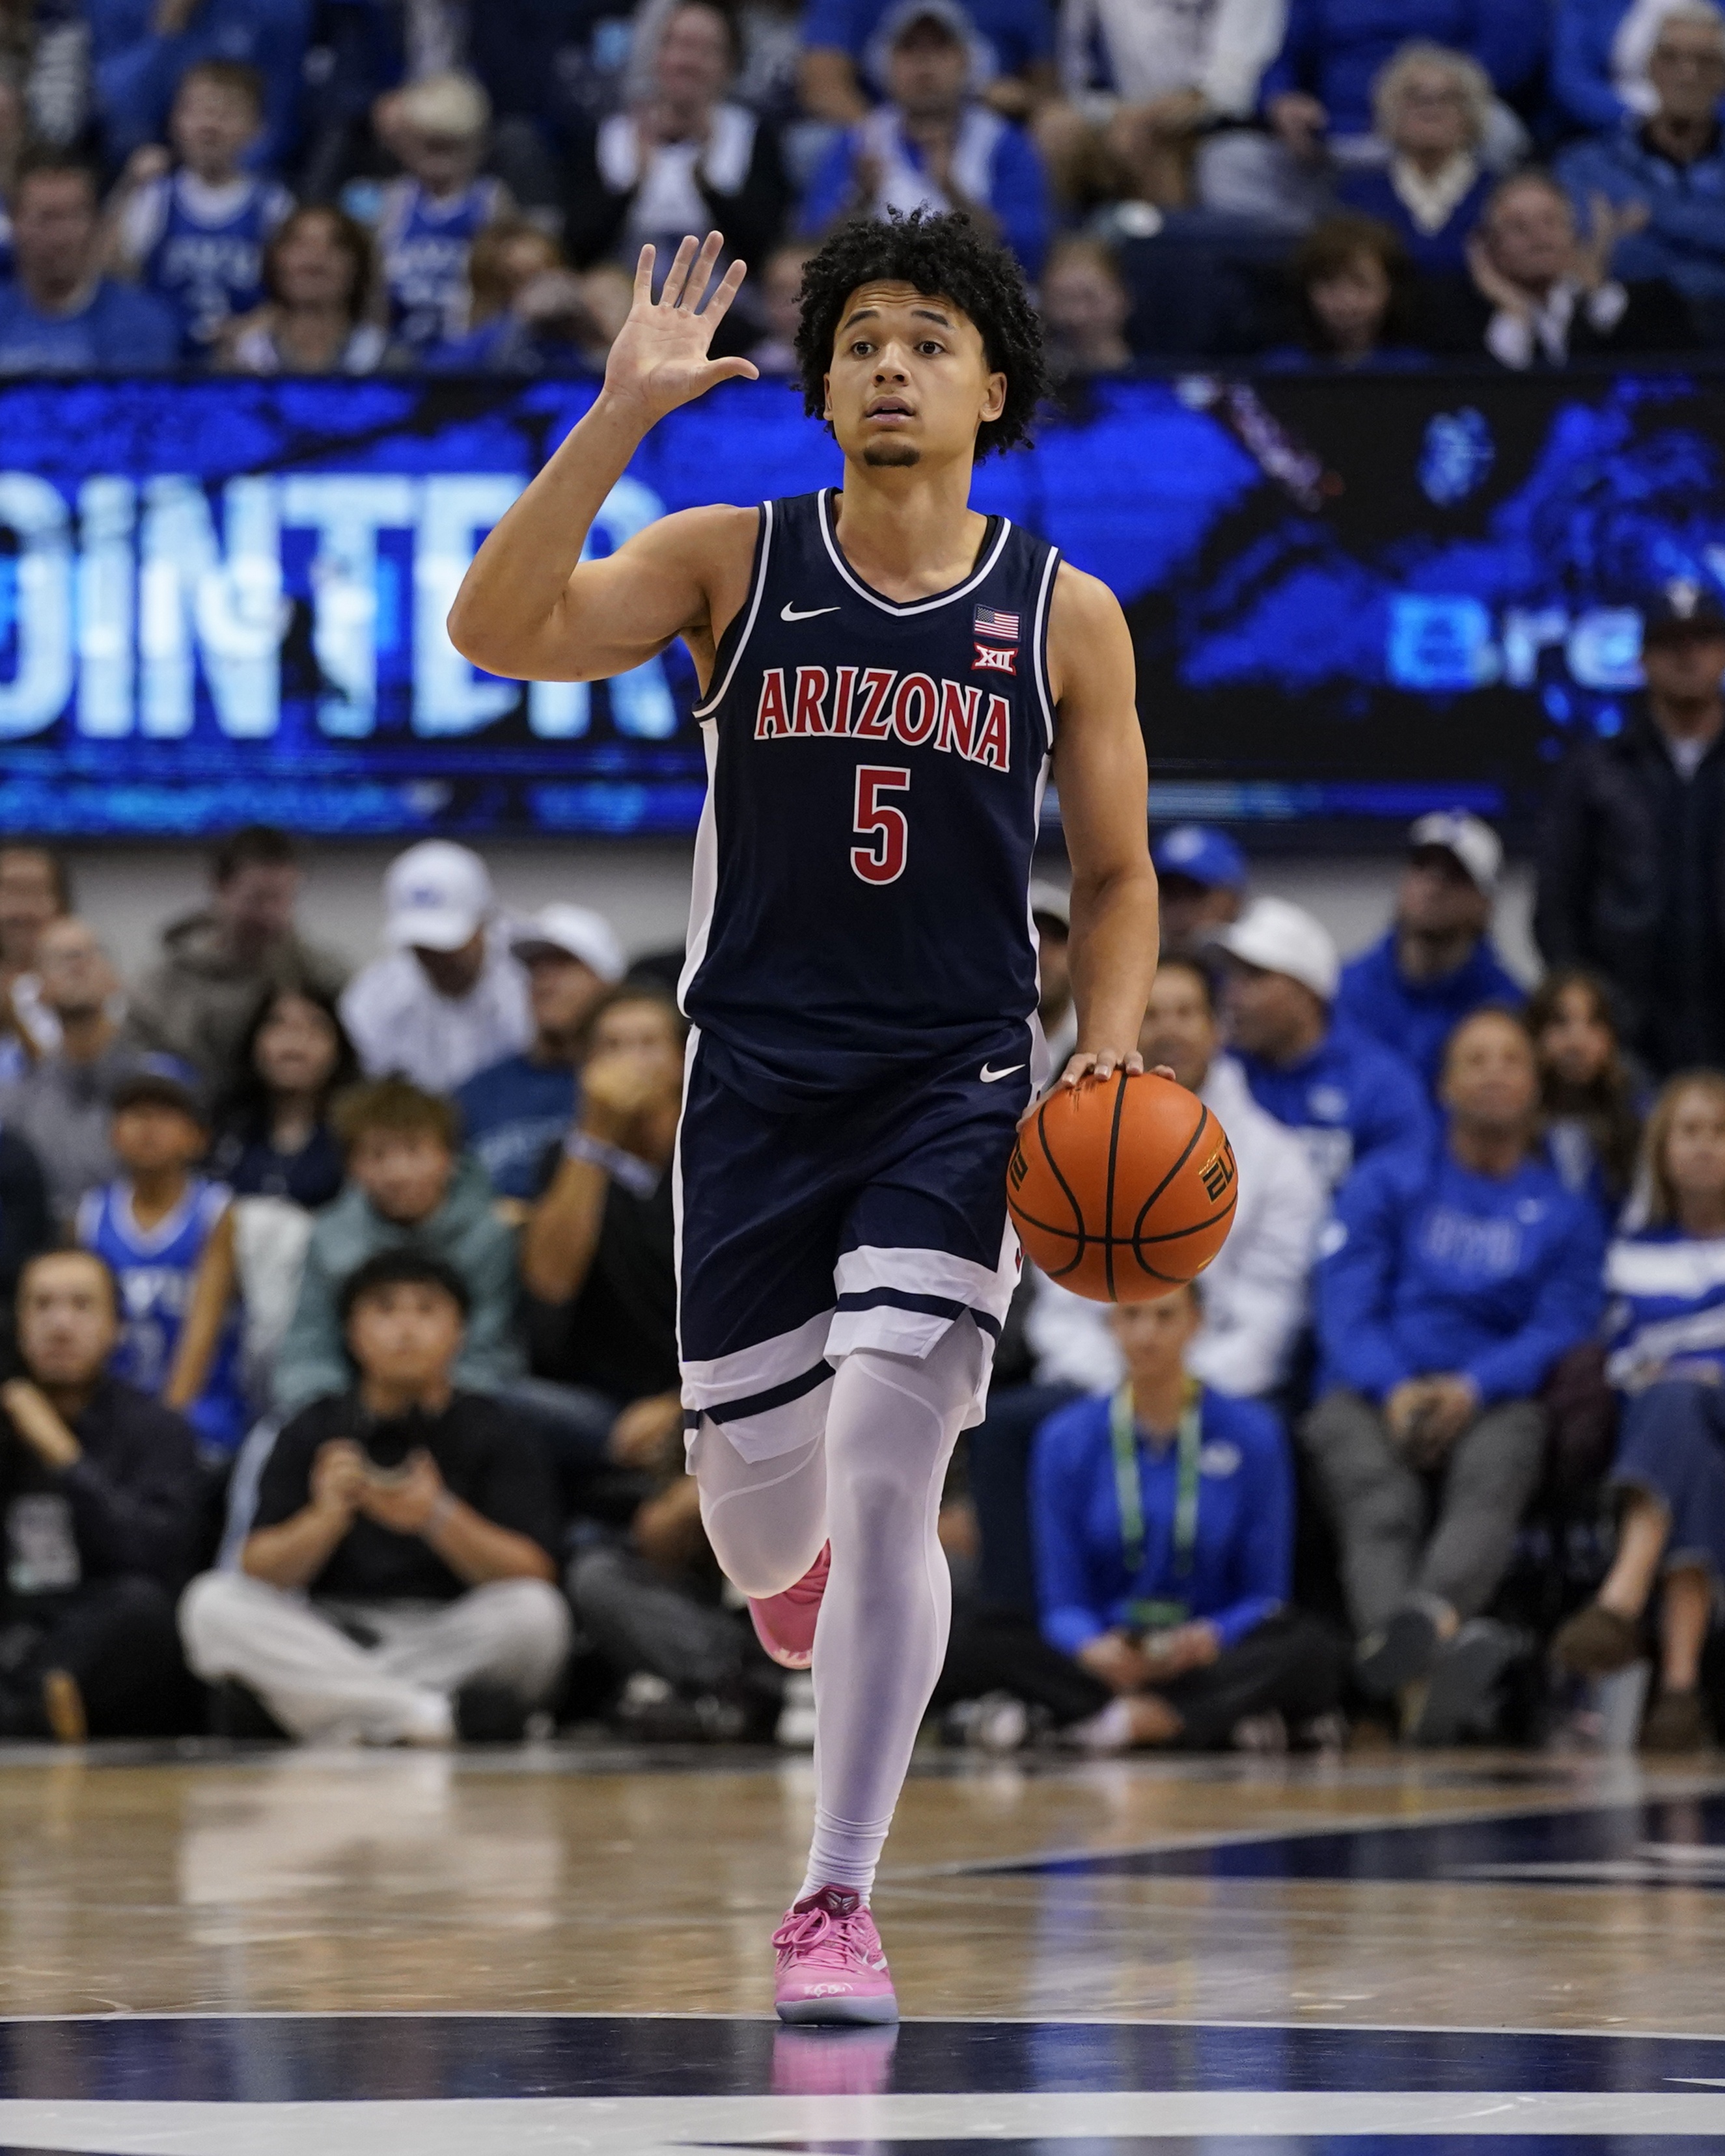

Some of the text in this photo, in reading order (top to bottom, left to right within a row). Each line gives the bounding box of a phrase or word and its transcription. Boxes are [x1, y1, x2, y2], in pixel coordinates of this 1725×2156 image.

[974, 644, 1015, 673] XII
[754, 666, 1010, 772] ARIZONA
[850, 765, 910, 885] 5
